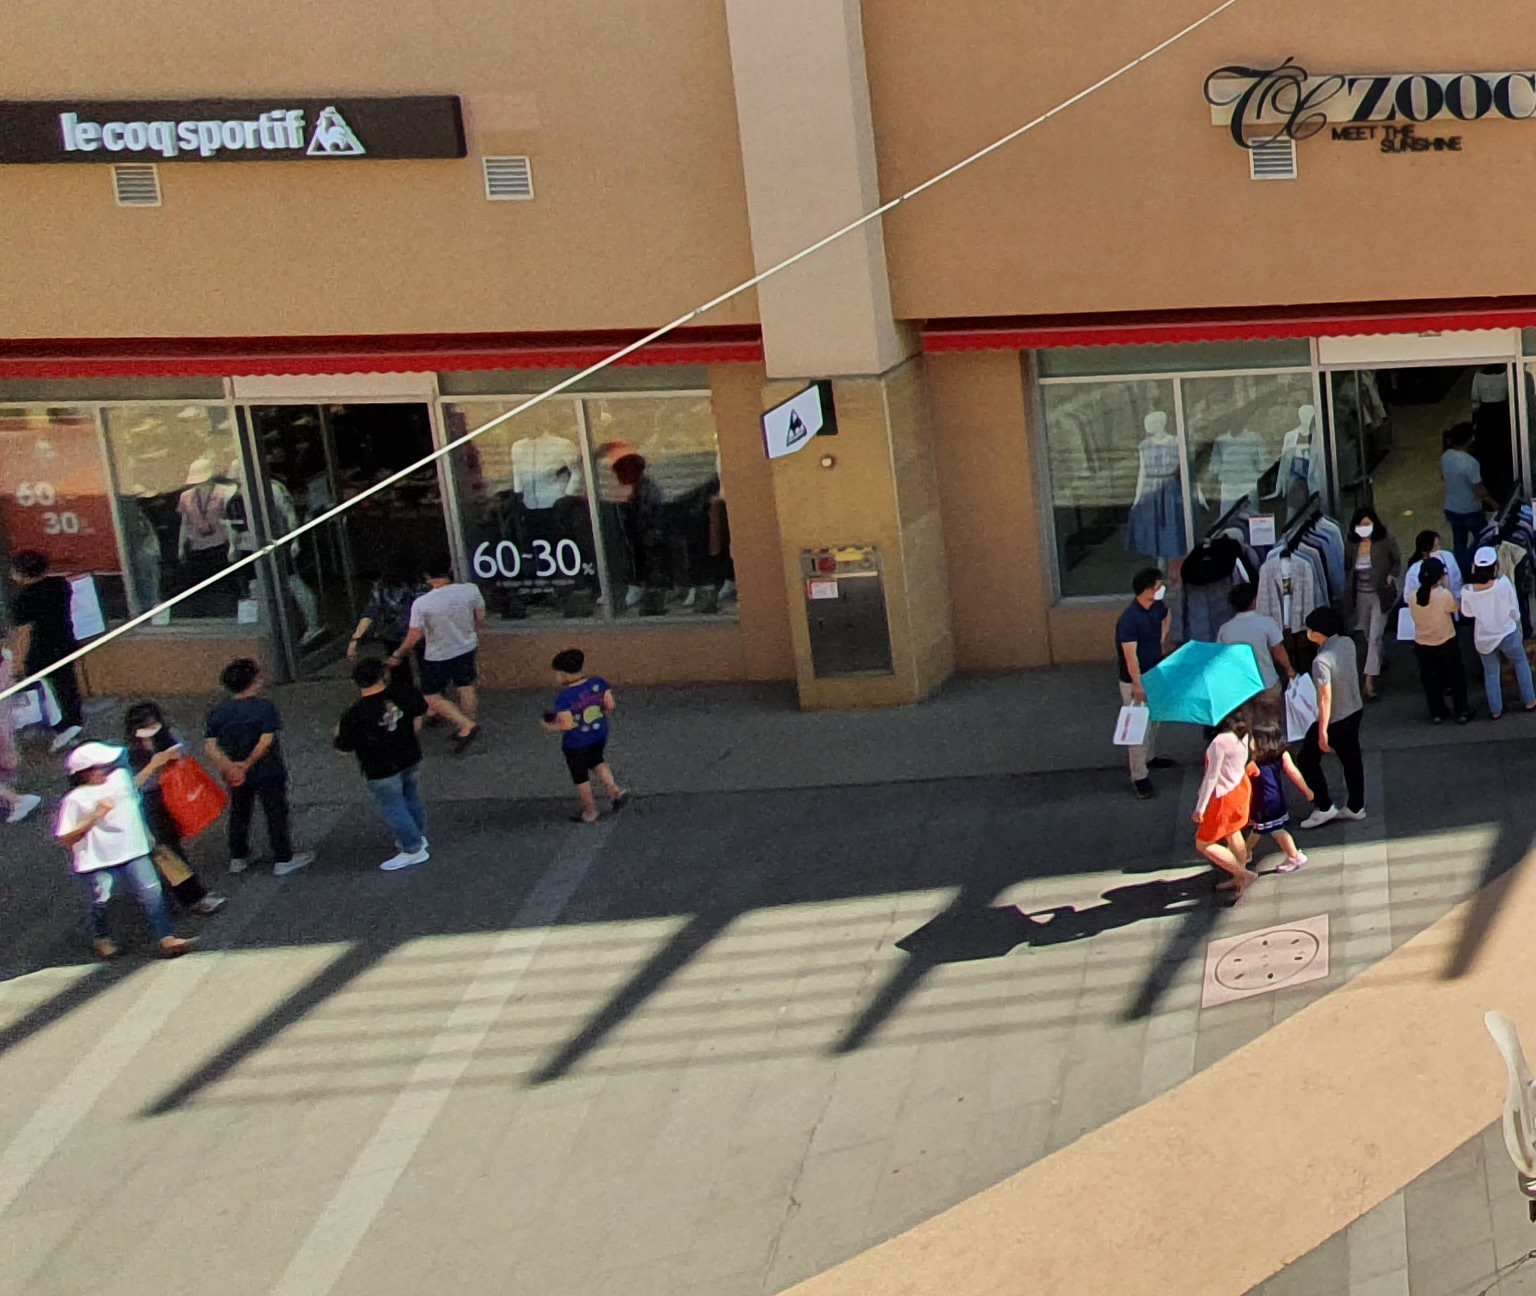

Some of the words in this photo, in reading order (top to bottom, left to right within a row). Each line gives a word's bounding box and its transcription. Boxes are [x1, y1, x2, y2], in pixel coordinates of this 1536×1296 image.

[1331, 125, 1377, 141] MEET
[1382, 124, 1415, 139] THE
[1380, 136, 1463, 153] SUNSHINE
